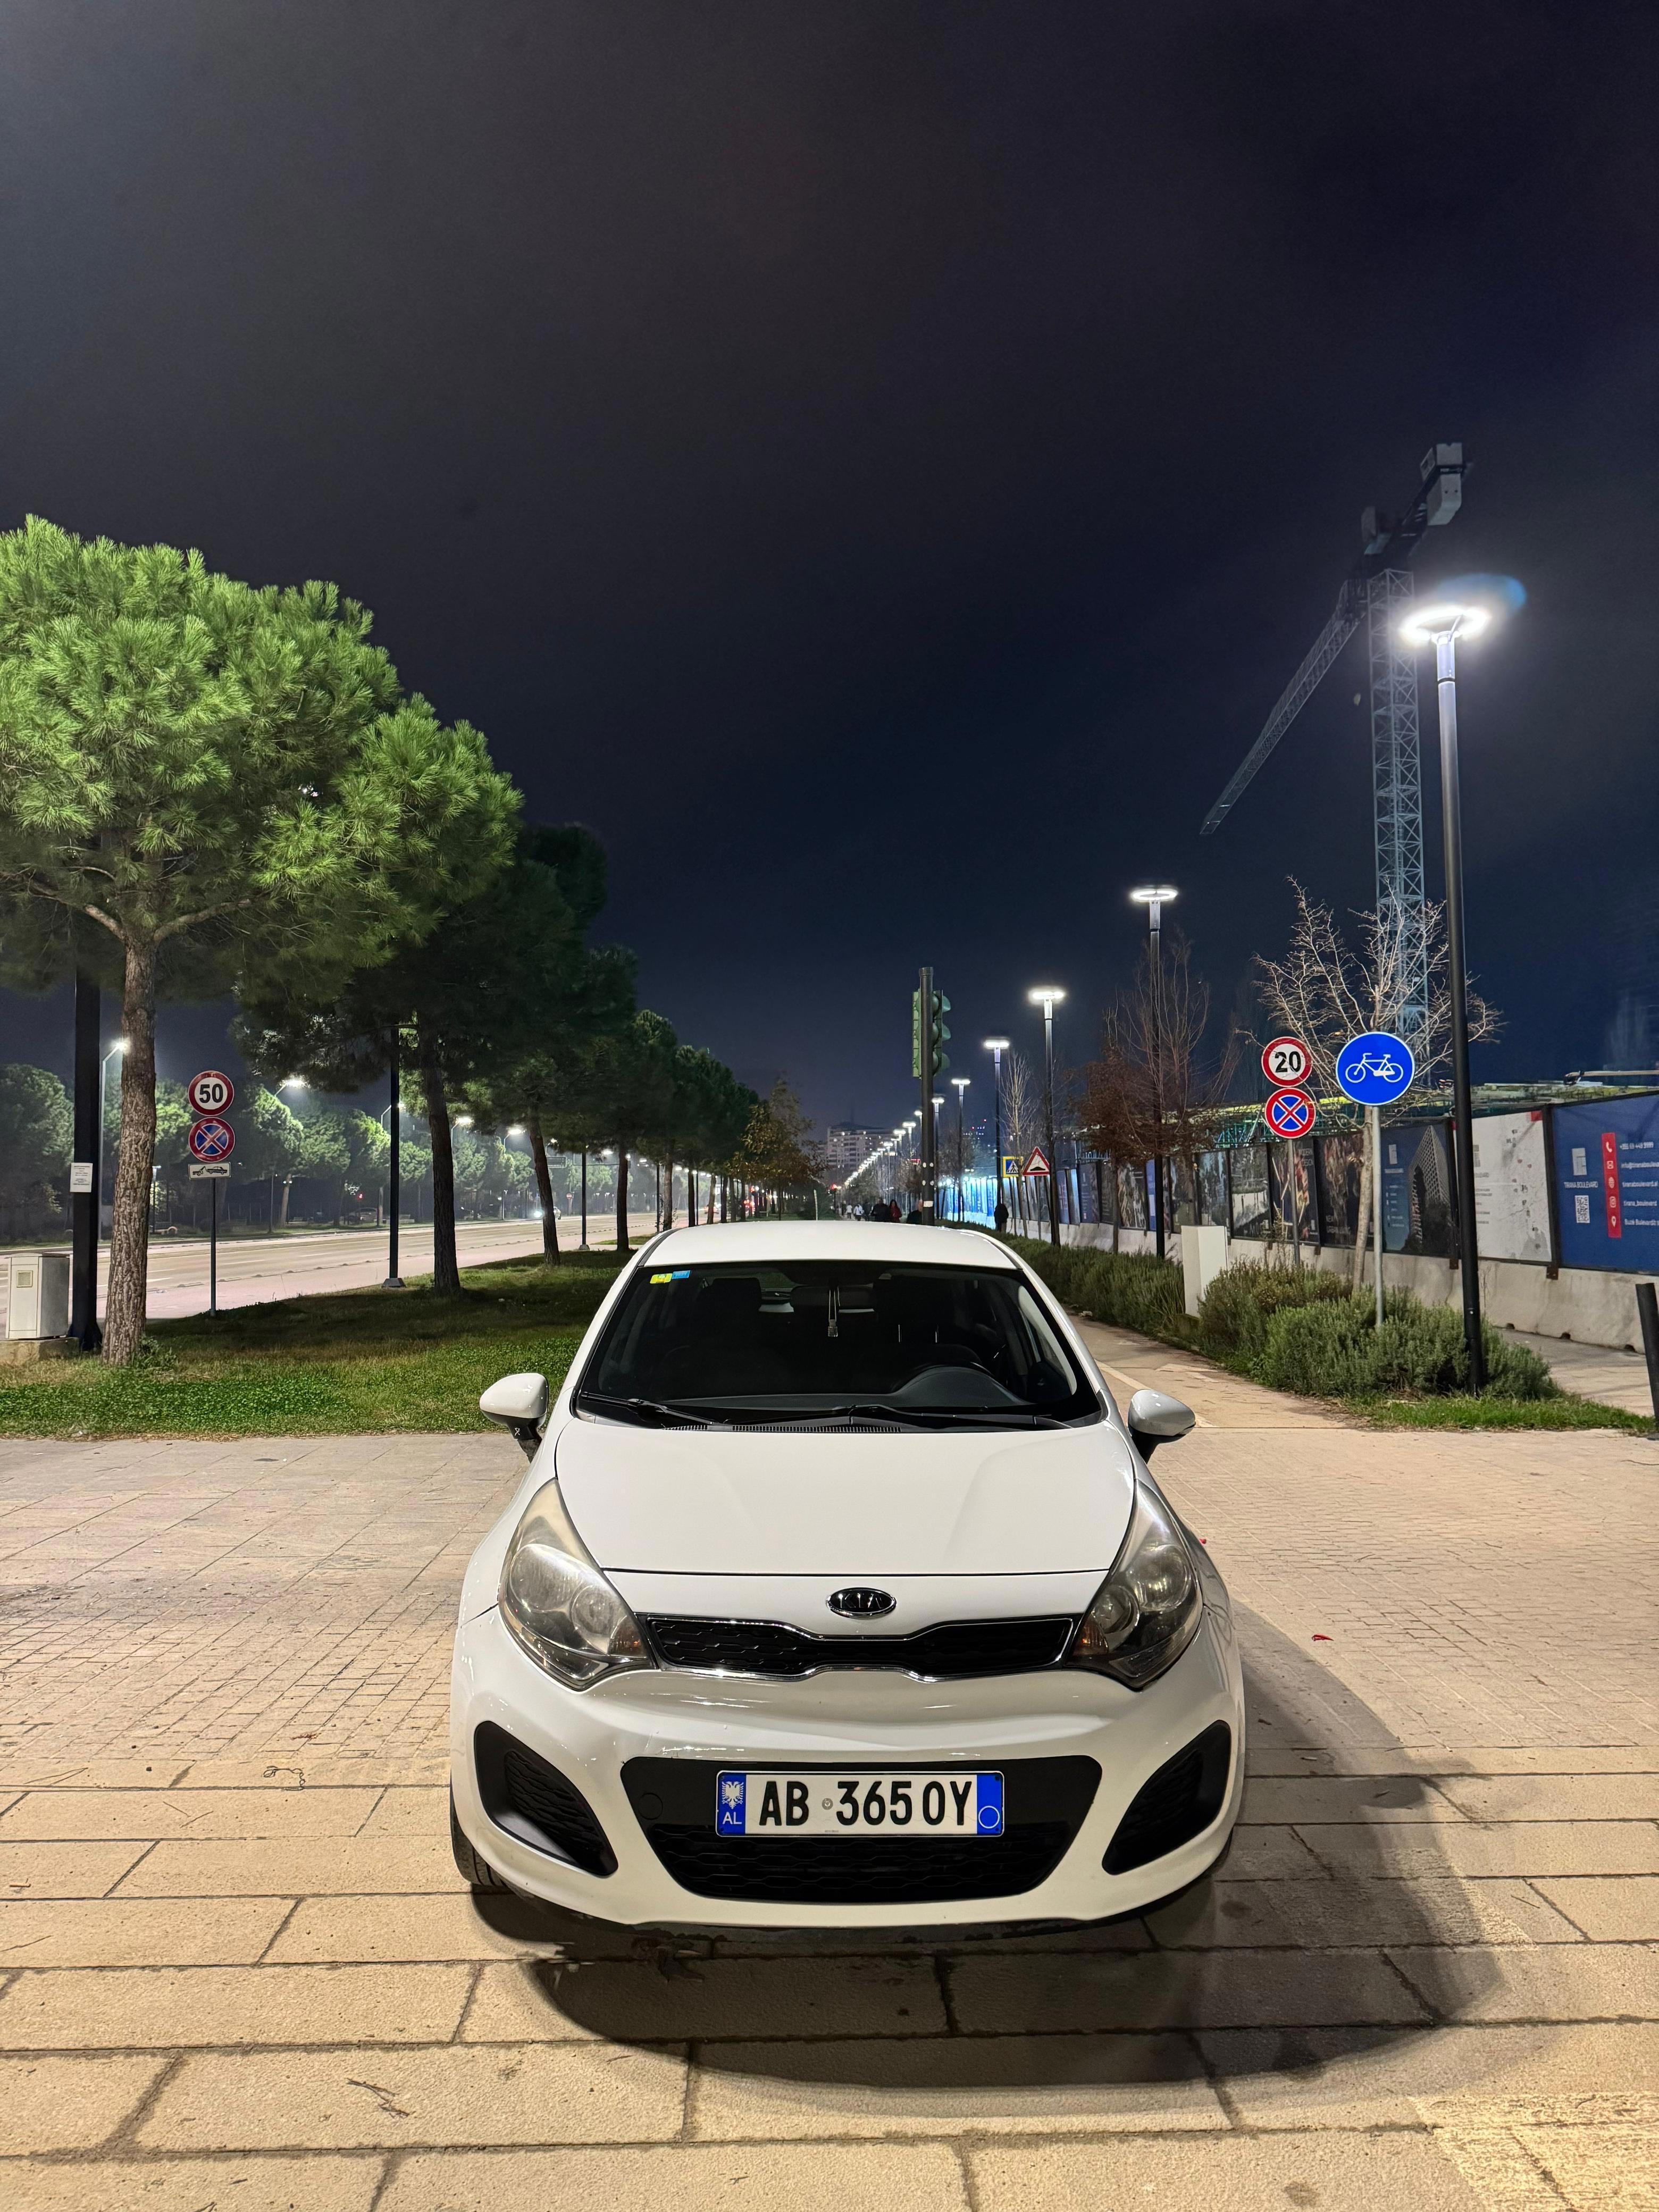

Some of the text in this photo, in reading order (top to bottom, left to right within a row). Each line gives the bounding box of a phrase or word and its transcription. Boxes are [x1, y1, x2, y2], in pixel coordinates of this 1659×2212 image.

[1275, 1051, 1301, 1073] 20
[199, 1083, 223, 1103] 50
[837, 1593, 883, 1609] KIA
[759, 1780, 809, 1826] AB
[836, 1780, 912, 1826] 365
[722, 1811, 742, 1825] AL
